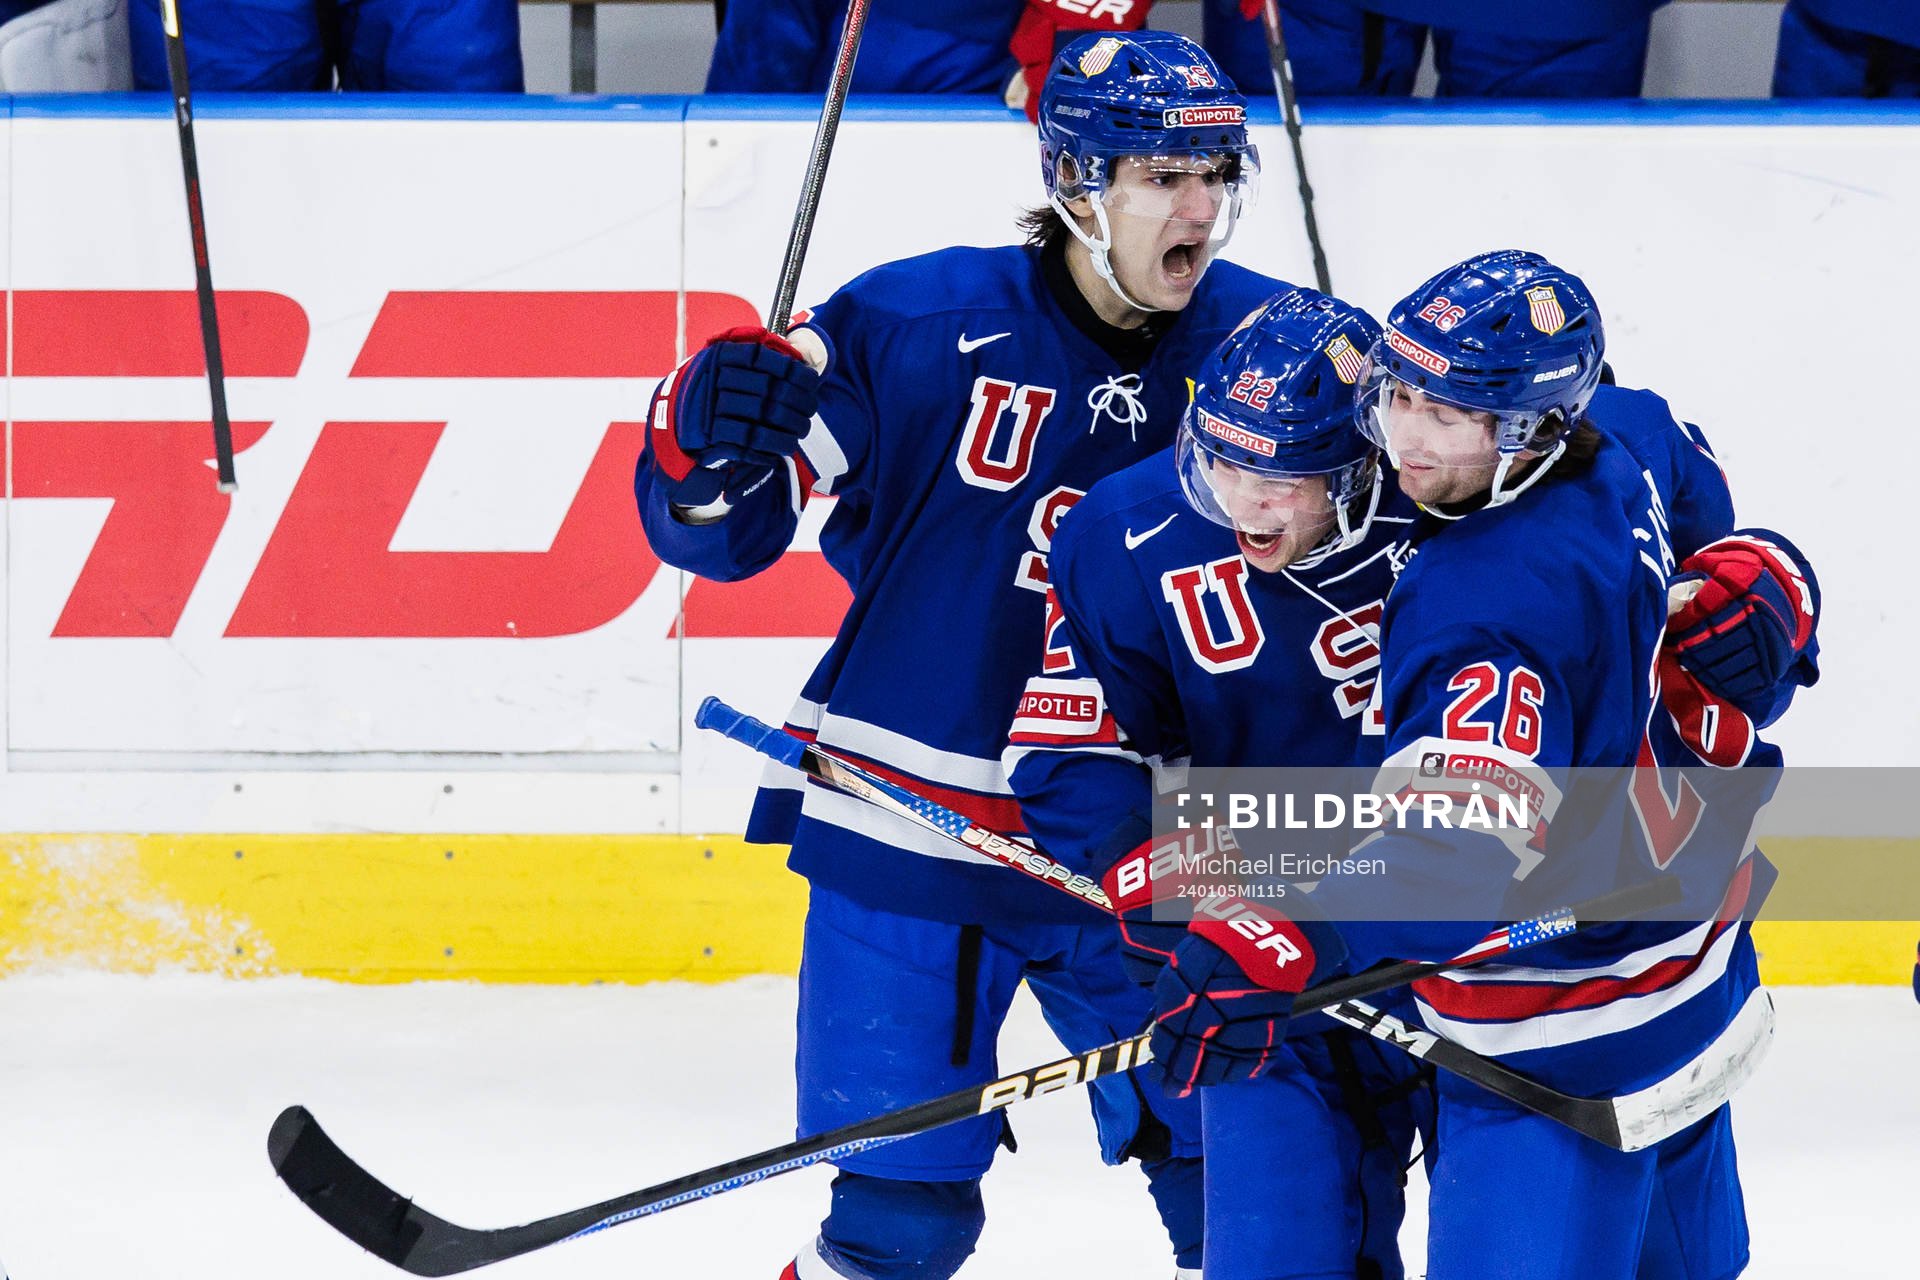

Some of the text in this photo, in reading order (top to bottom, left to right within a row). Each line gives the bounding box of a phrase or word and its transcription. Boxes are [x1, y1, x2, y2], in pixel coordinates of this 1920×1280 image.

[1185, 110, 1241, 123] CHIPOTLE
[1418, 296, 1467, 333] 26
[1392, 334, 1446, 372] CHIPOTLE
[1229, 371, 1277, 412] 22
[1532, 364, 1578, 384] BAUER
[1208, 420, 1272, 453] CHIPOTLE
[1442, 661, 1546, 761] 26
[1451, 757, 1545, 811] CHIPOTLE
[961, 826, 1114, 910] JETSPEE
[1194, 893, 1302, 969] UER
